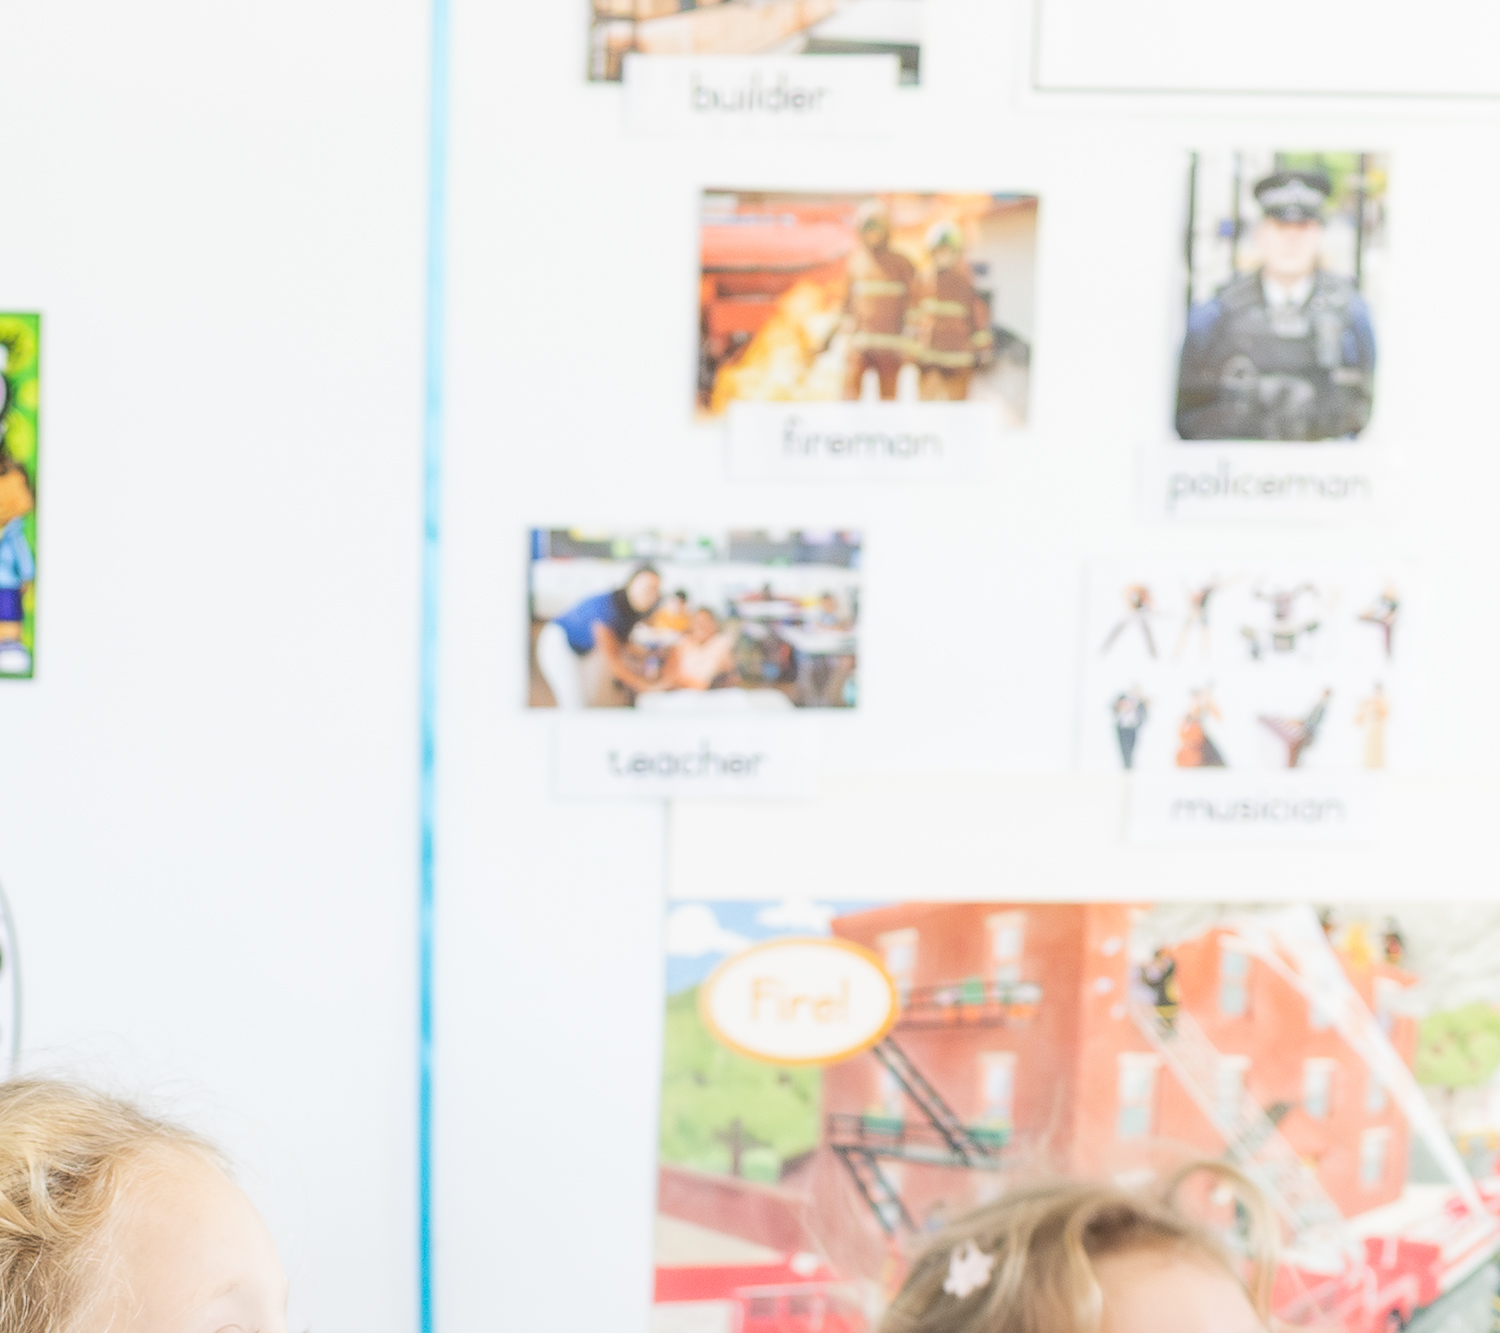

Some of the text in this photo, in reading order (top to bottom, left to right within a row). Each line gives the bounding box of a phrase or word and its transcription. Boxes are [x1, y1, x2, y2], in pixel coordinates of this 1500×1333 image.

[690, 73, 827, 114] builder
[781, 415, 941, 460] fireman
[1164, 456, 1370, 516] policeman
[606, 741, 764, 780] teacher
[750, 976, 850, 1024] Fire!
